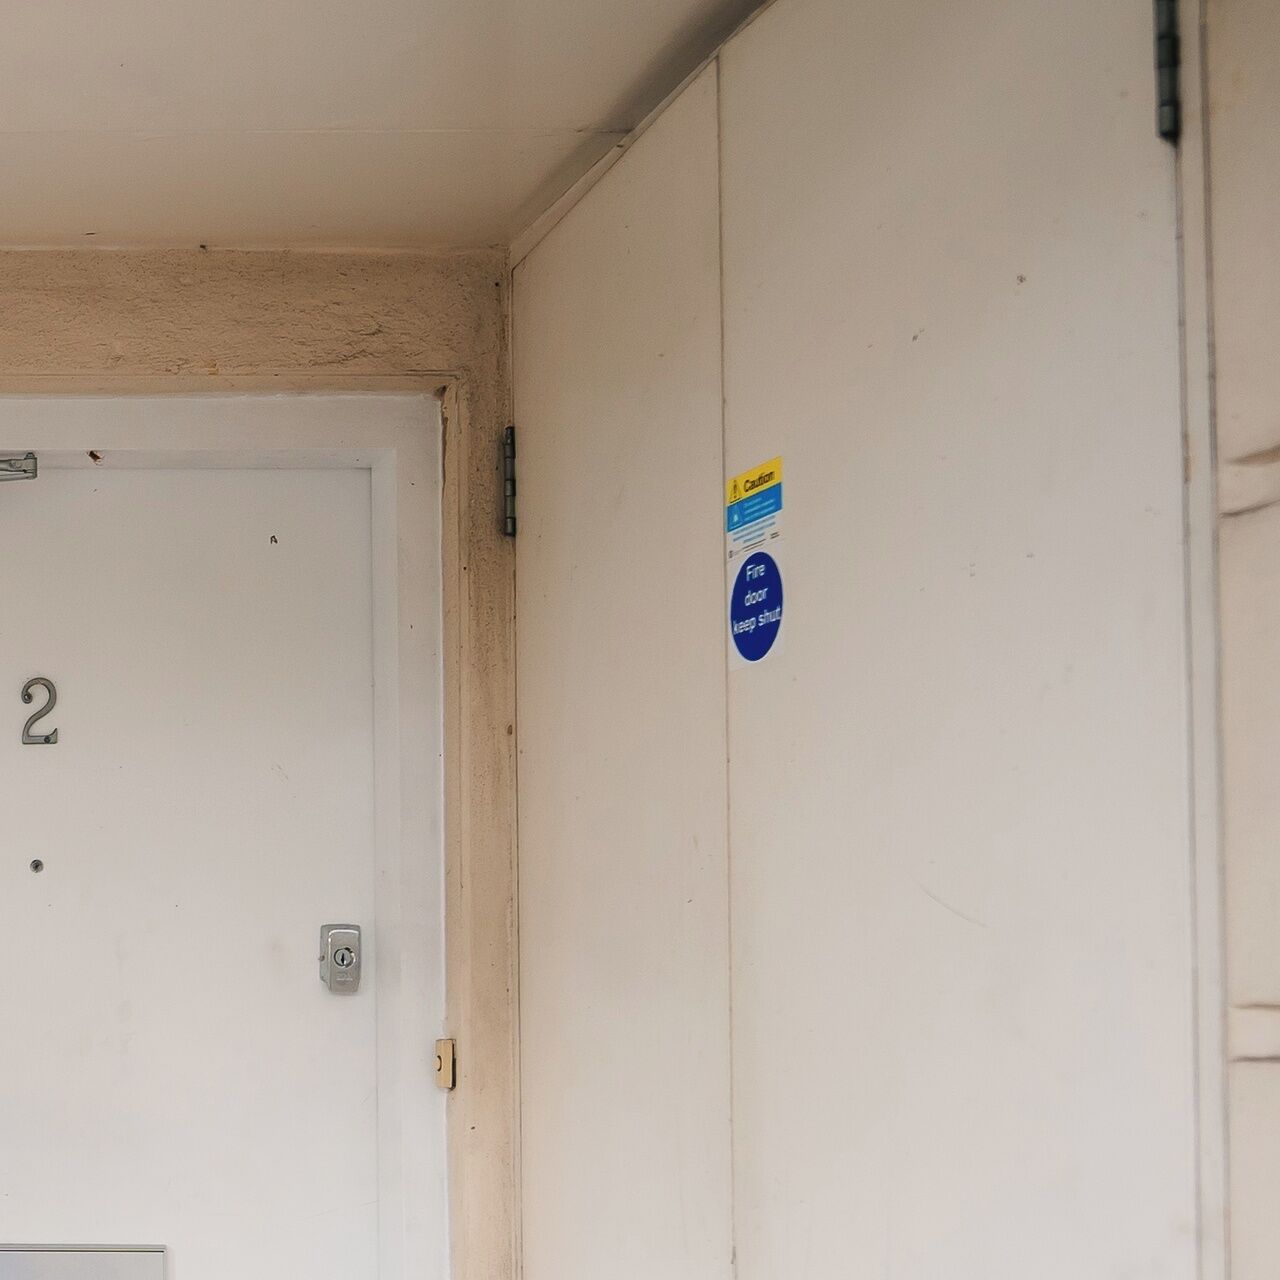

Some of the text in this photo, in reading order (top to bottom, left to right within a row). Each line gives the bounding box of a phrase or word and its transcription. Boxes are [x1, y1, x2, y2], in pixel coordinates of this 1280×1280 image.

[743, 471, 775, 493] Caution
[746, 564, 766, 581] Fire
[744, 587, 768, 606] door
[733, 606, 781, 635] keep shut
[21, 677, 58, 745] 2
